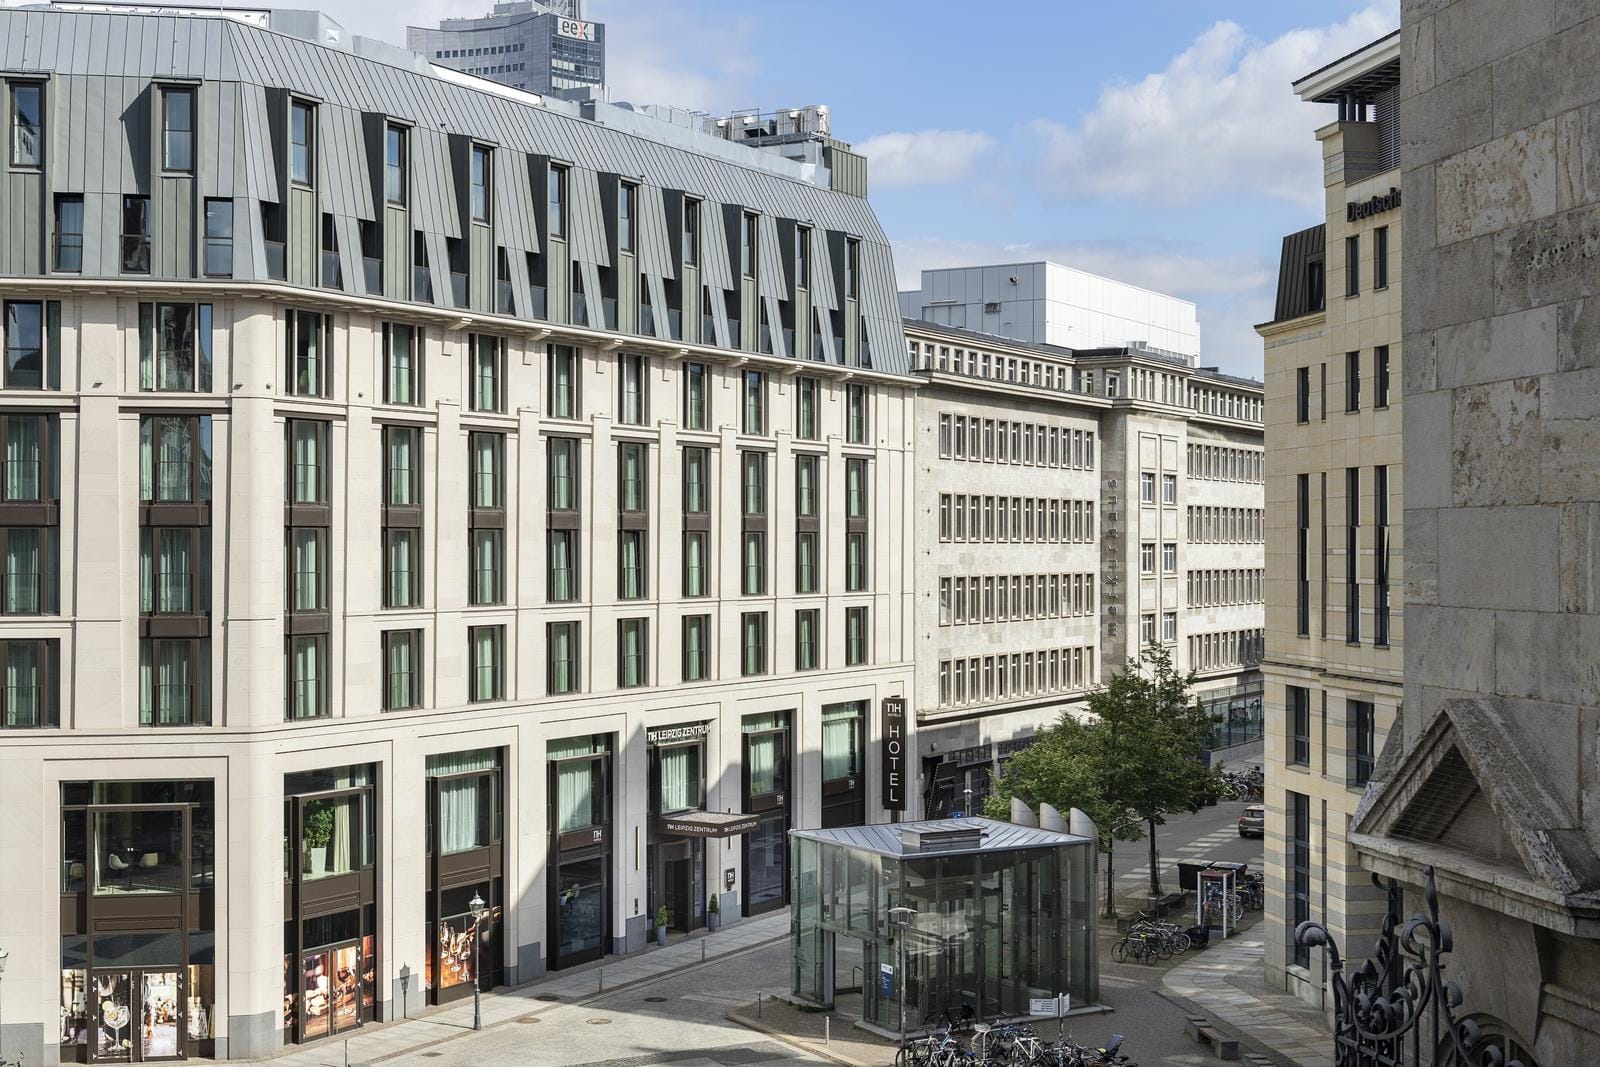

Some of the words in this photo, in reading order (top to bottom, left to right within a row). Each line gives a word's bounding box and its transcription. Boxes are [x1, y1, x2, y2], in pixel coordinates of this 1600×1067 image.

[562, 20, 589, 40] eex
[658, 728, 682, 740] LEIPZIG
[682, 724, 711, 737] ZENTRUM
[888, 724, 900, 802] HOTEL
[675, 824, 693, 832] LEIPZIG
